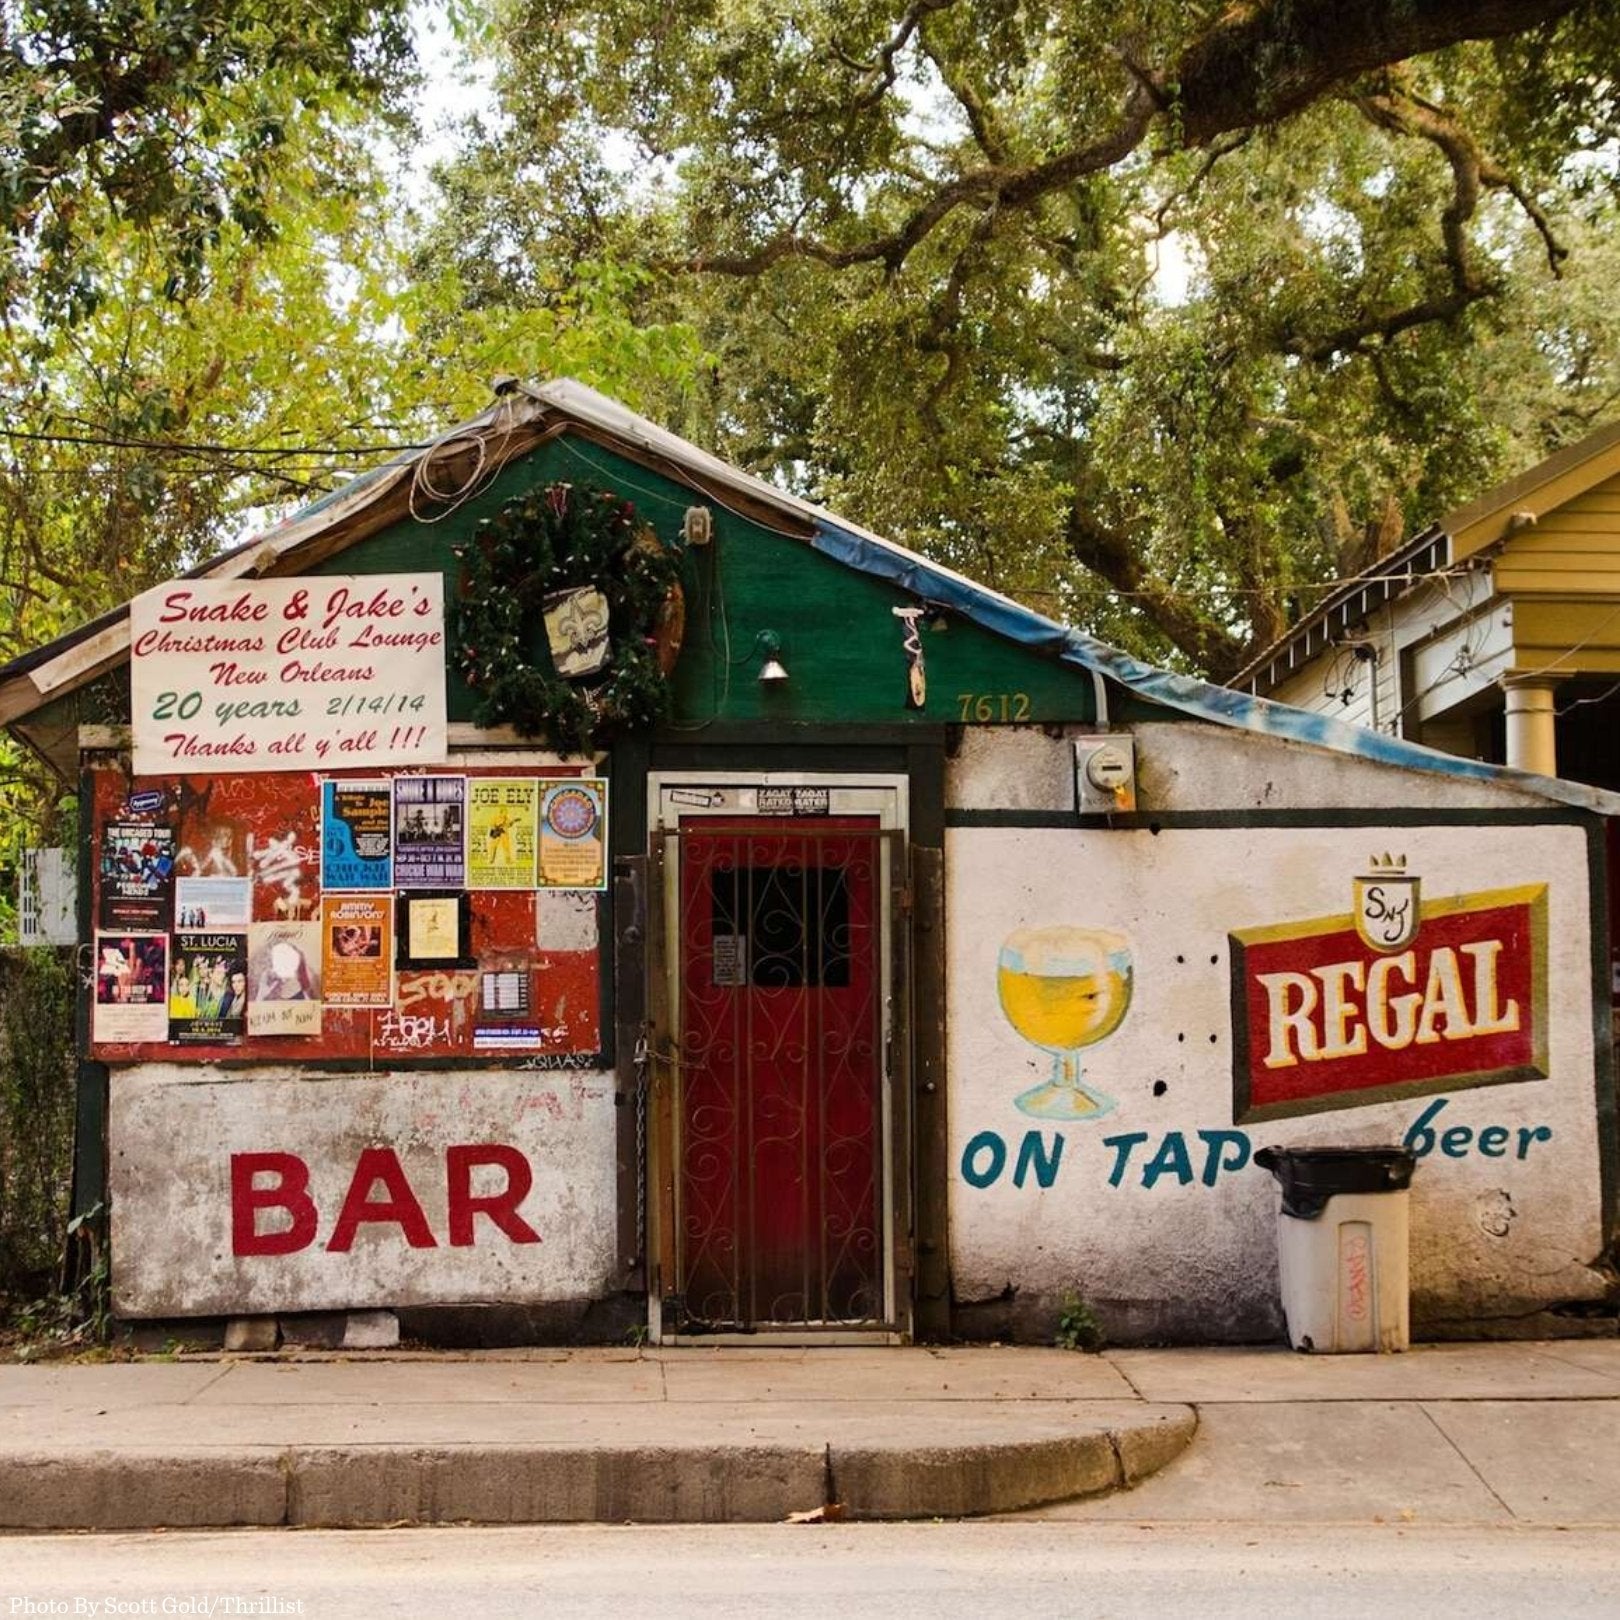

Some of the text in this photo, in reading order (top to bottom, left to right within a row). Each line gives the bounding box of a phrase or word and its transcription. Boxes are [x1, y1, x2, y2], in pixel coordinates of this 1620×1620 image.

[160, 586, 431, 628] Snake & Jake's
[134, 624, 441, 657] Christmas Club Lounge
[209, 660, 375, 686] New Orleans
[152, 691, 425, 726] 20 years 2/14/14
[956, 693, 1031, 722] 7612
[163, 726, 427, 758] Thanks all y'all !!!
[471, 788, 499, 804] JOE
[506, 788, 534, 804] ELY
[181, 935, 238, 948] ST. LUCIA
[1255, 939, 1520, 1069] REGAL
[1402, 1098, 1553, 1160] beer
[961, 1130, 1251, 1189] ON TAP
[231, 1143, 543, 1257] BAR
